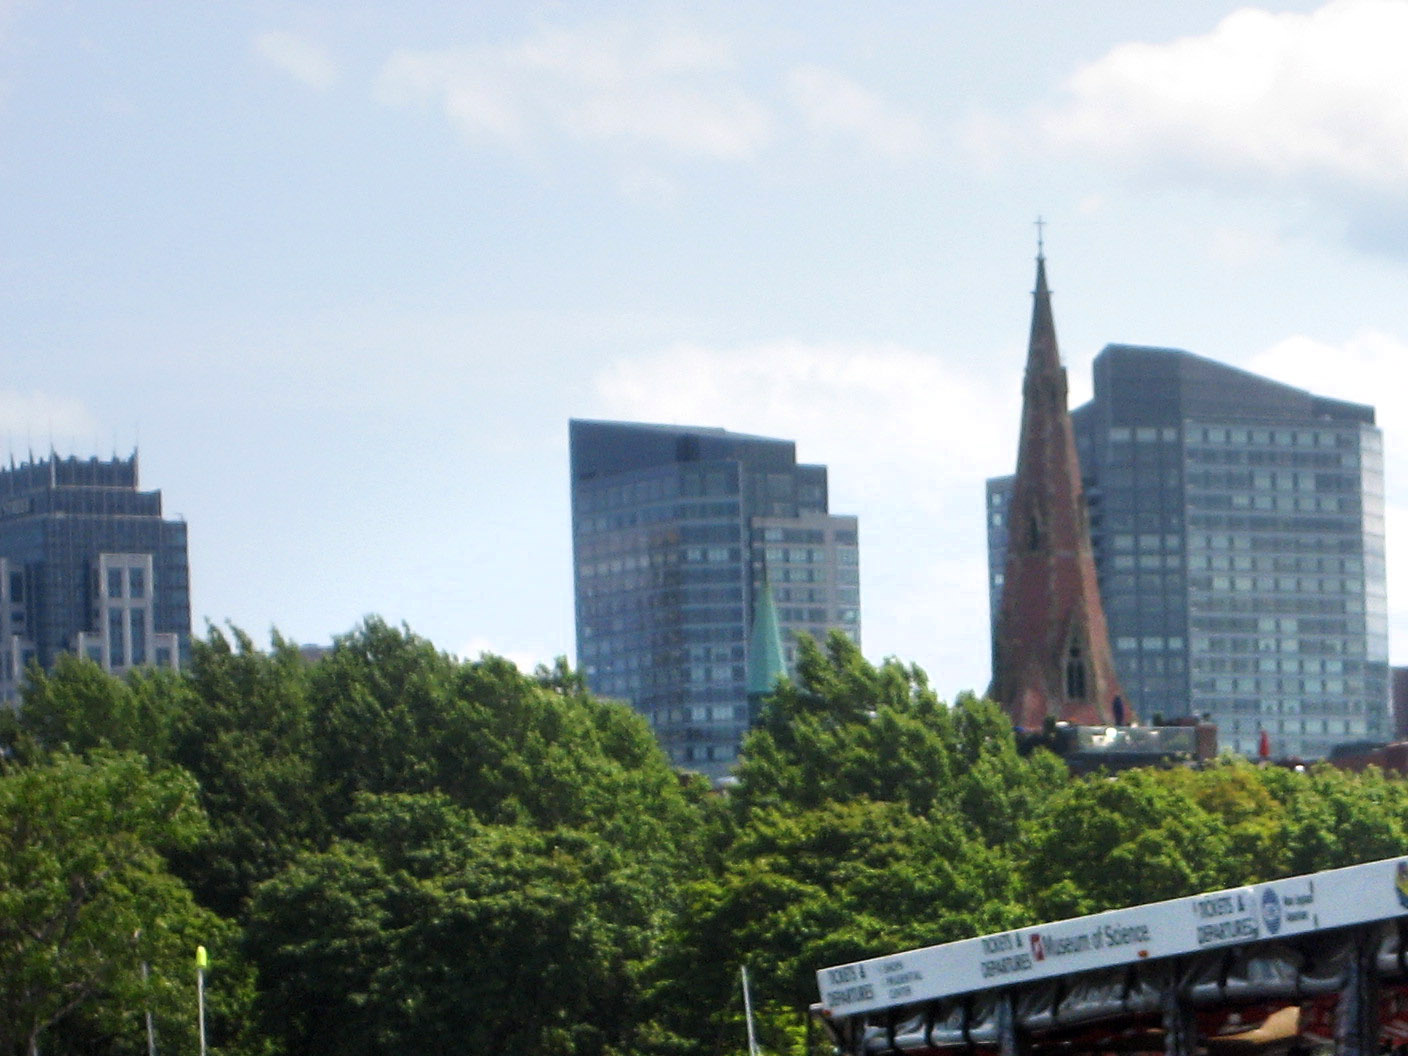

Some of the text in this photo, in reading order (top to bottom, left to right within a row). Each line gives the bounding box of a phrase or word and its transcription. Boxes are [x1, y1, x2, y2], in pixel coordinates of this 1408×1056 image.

[1042, 924, 1151, 956] Museum of Science
